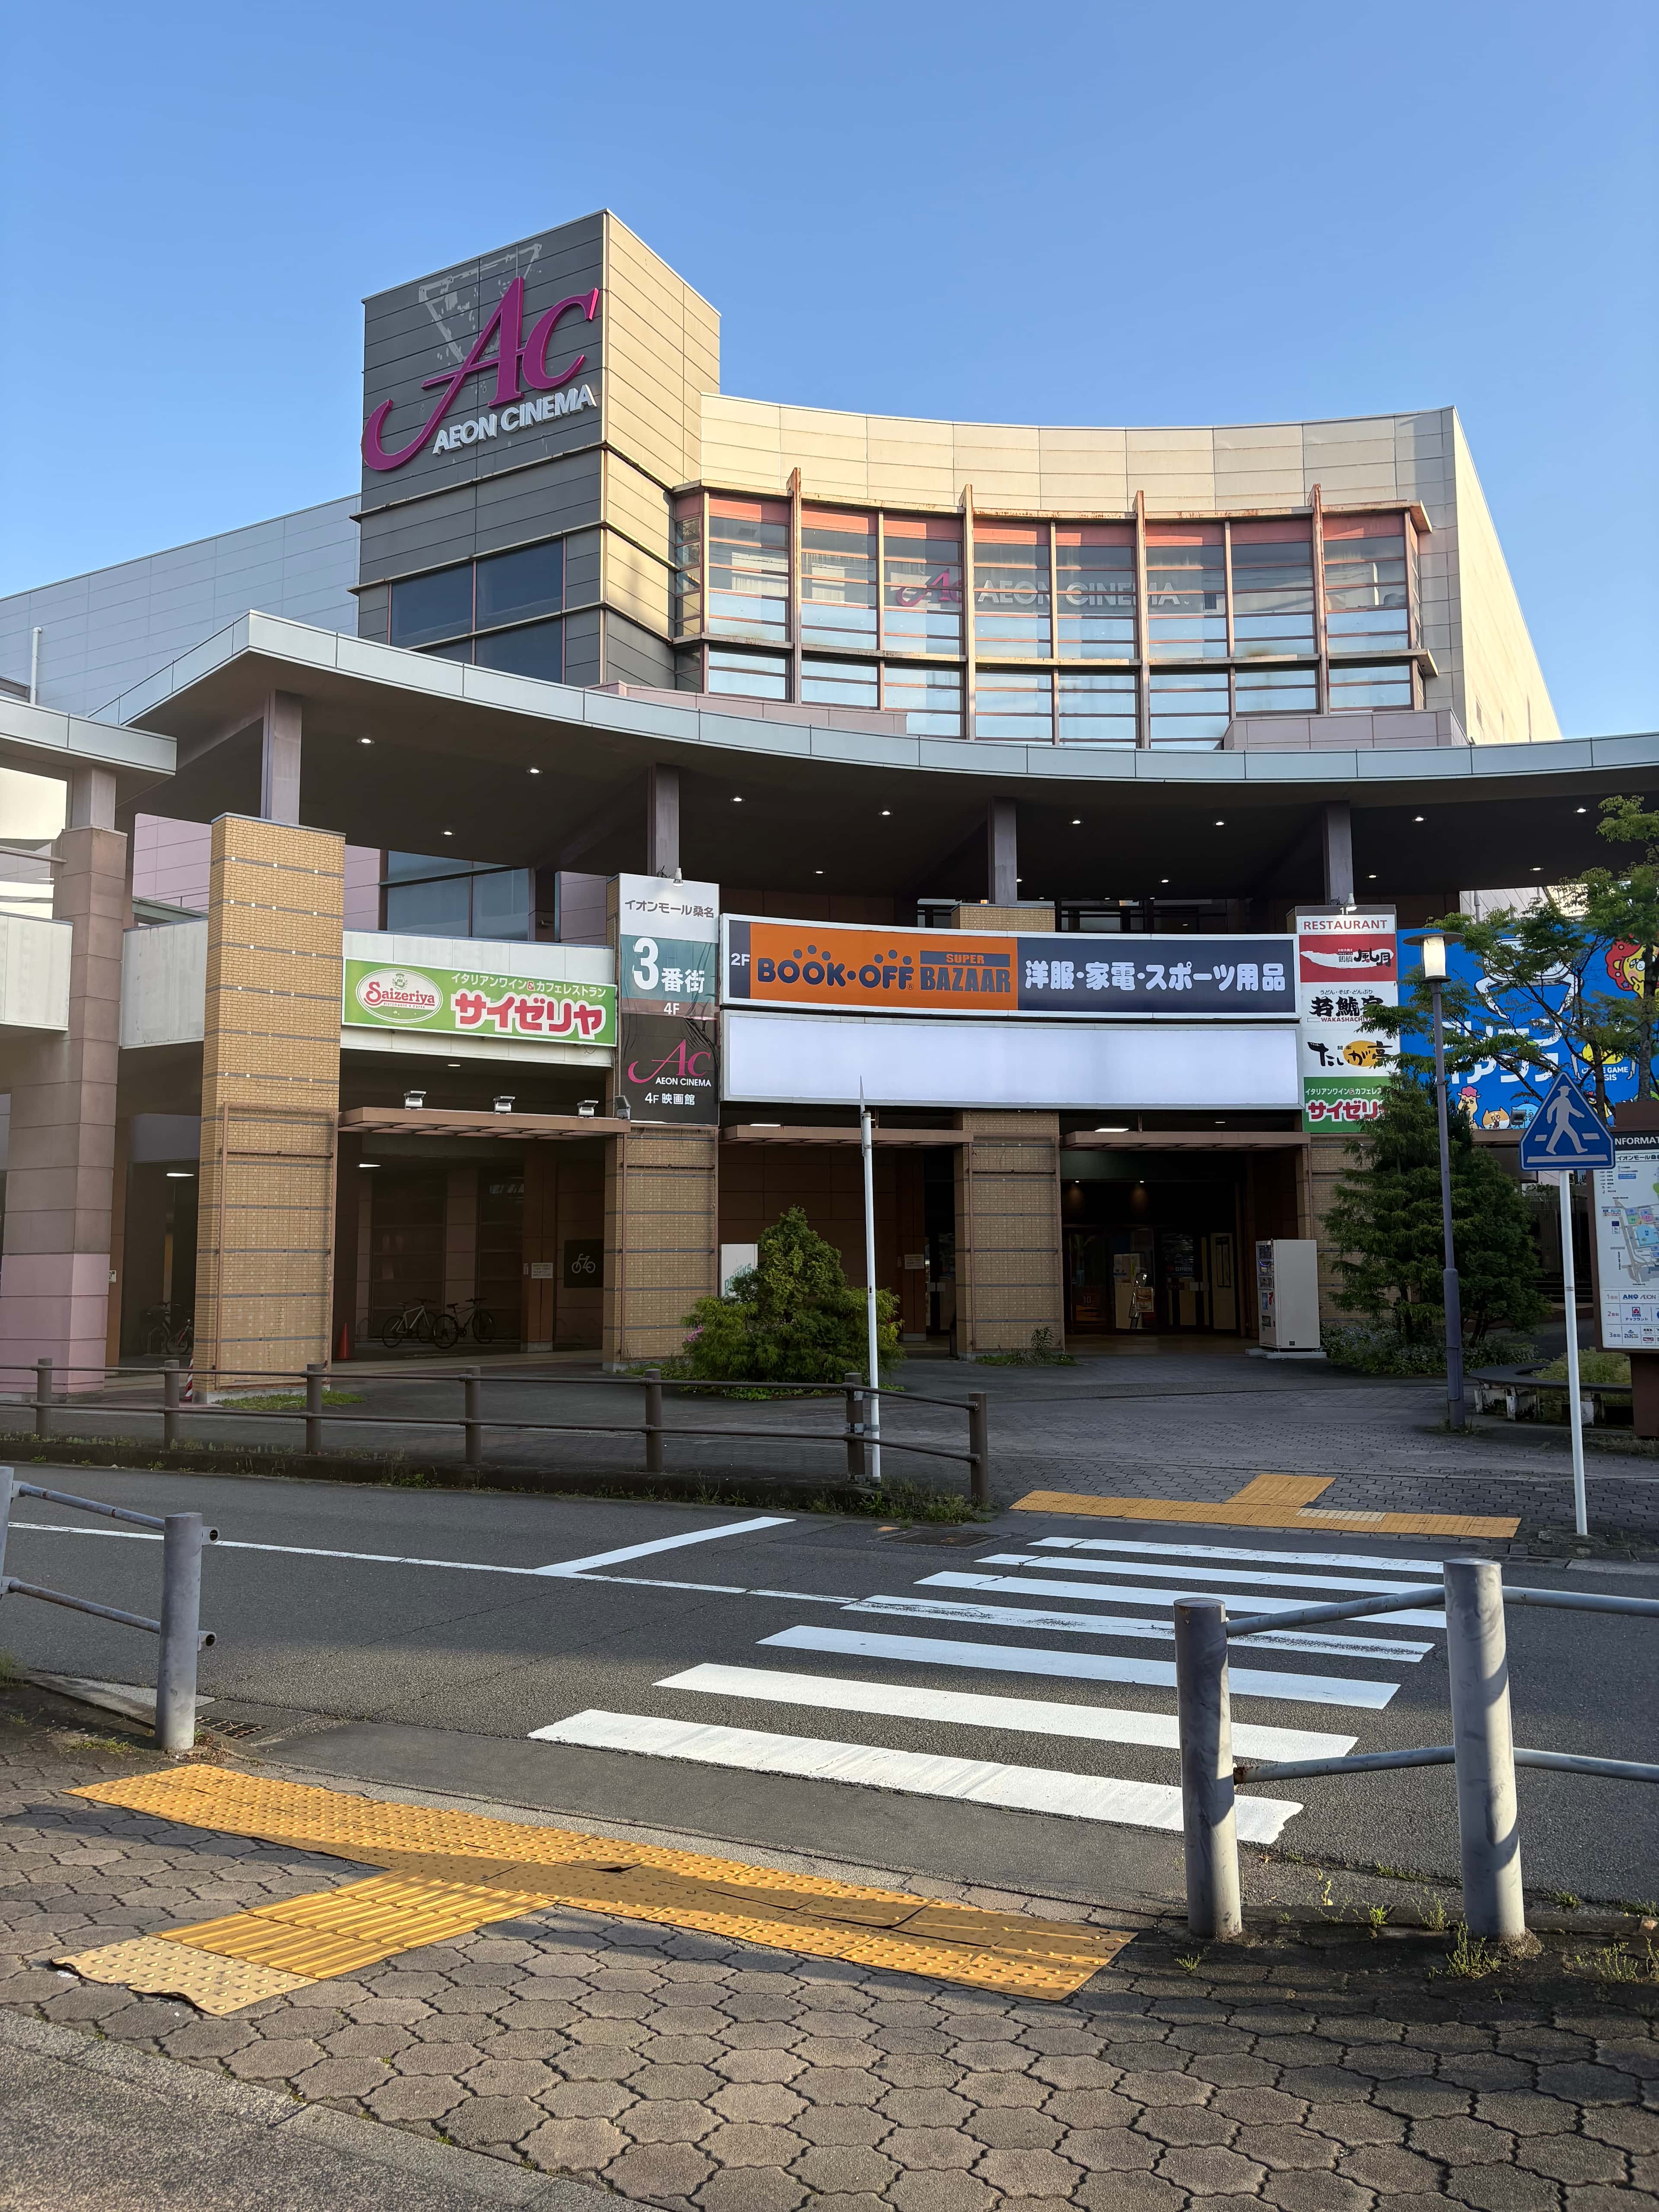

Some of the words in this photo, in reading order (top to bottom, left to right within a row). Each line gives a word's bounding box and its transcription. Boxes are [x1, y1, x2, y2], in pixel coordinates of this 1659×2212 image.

[432, 413, 497, 455] AEON
[501, 384, 597, 432] CINEMA
[978, 580, 1050, 604] AEON
[625, 899, 714, 918] イオンモール桑名
[1304, 920, 1387, 930] RESTAURANT
[632, 937, 705, 992] 3番街
[731, 953, 750, 966] 2F
[946, 953, 985, 964] SUPER
[451, 973, 606, 998] イタリアンワイン&カフェレストラン
[920, 966, 1010, 992] BAZAAR
[1025, 960, 1285, 992] 洋服・家電・スポーツ用品
[366, 982, 435, 1004] Saizeriya
[455, 992, 602, 1035] サイゼリヤ
[664, 1002, 680, 1015] 4F
[655, 1077, 678, 1086] AEON
[680, 1077, 712, 1087] CINEMA
[645, 1093, 659, 1104] 4F
[662, 1093, 695, 1106] 映画館
[1308, 1100, 1385, 1119] サイゼリ
[1615, 1136, 1659, 1145] NFORMAT
